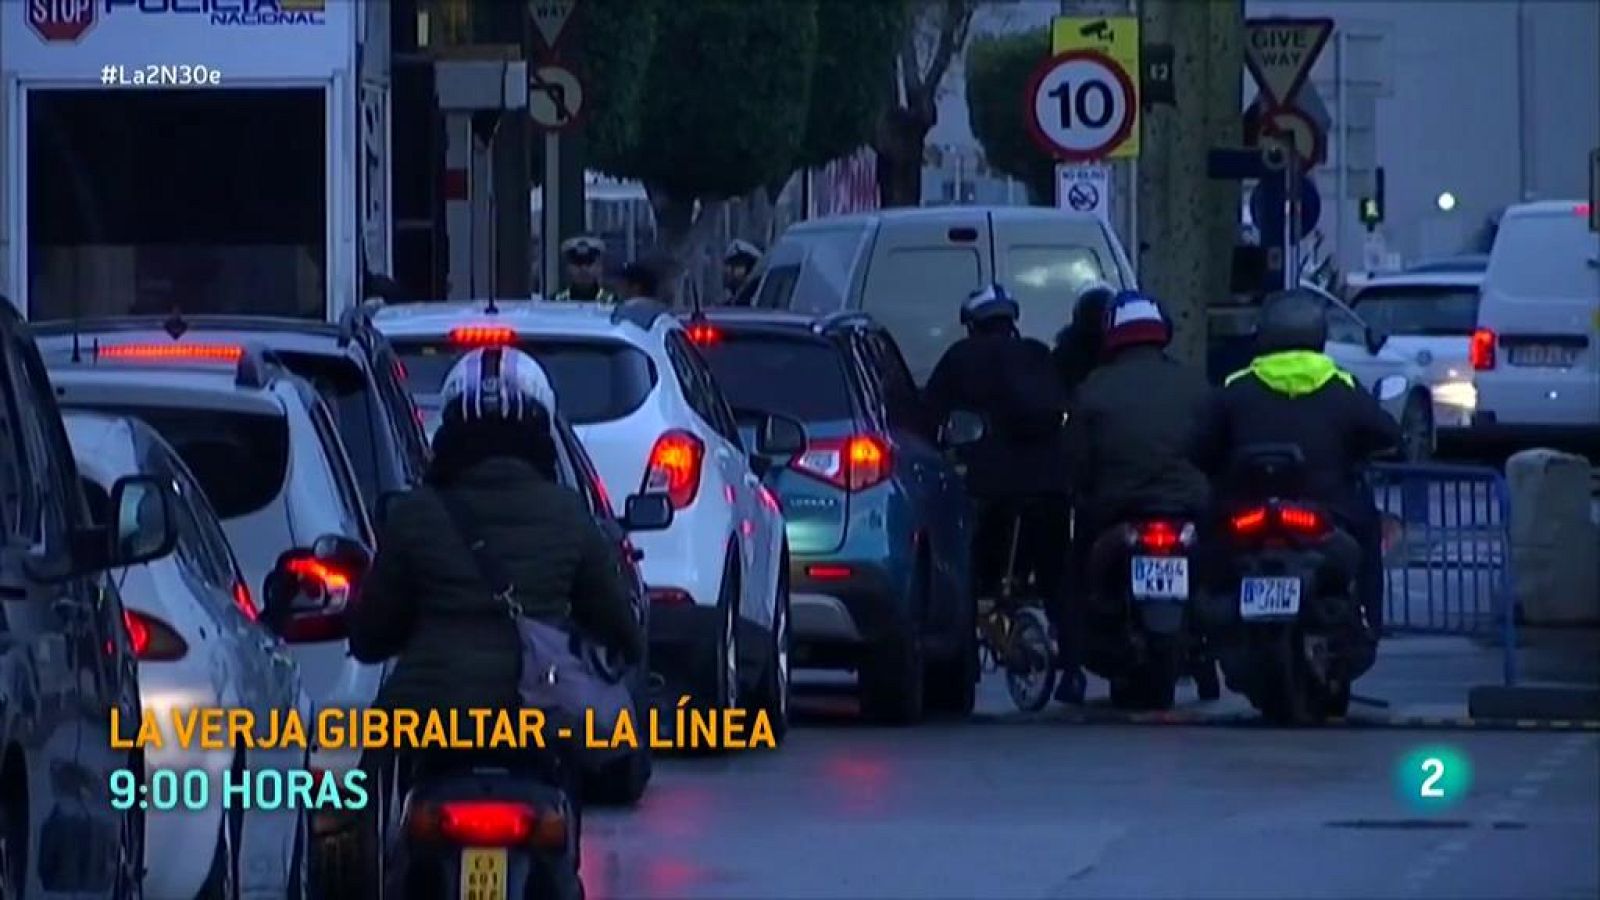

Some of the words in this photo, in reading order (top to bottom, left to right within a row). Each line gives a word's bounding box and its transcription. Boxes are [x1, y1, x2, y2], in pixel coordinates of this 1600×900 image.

[33, 0, 89, 24] STOP
[210, 12, 326, 26] NACIONAL
[1251, 30, 1307, 49] GIVE
[1263, 51, 1301, 66] WAY
[1047, 79, 1115, 129] 10
